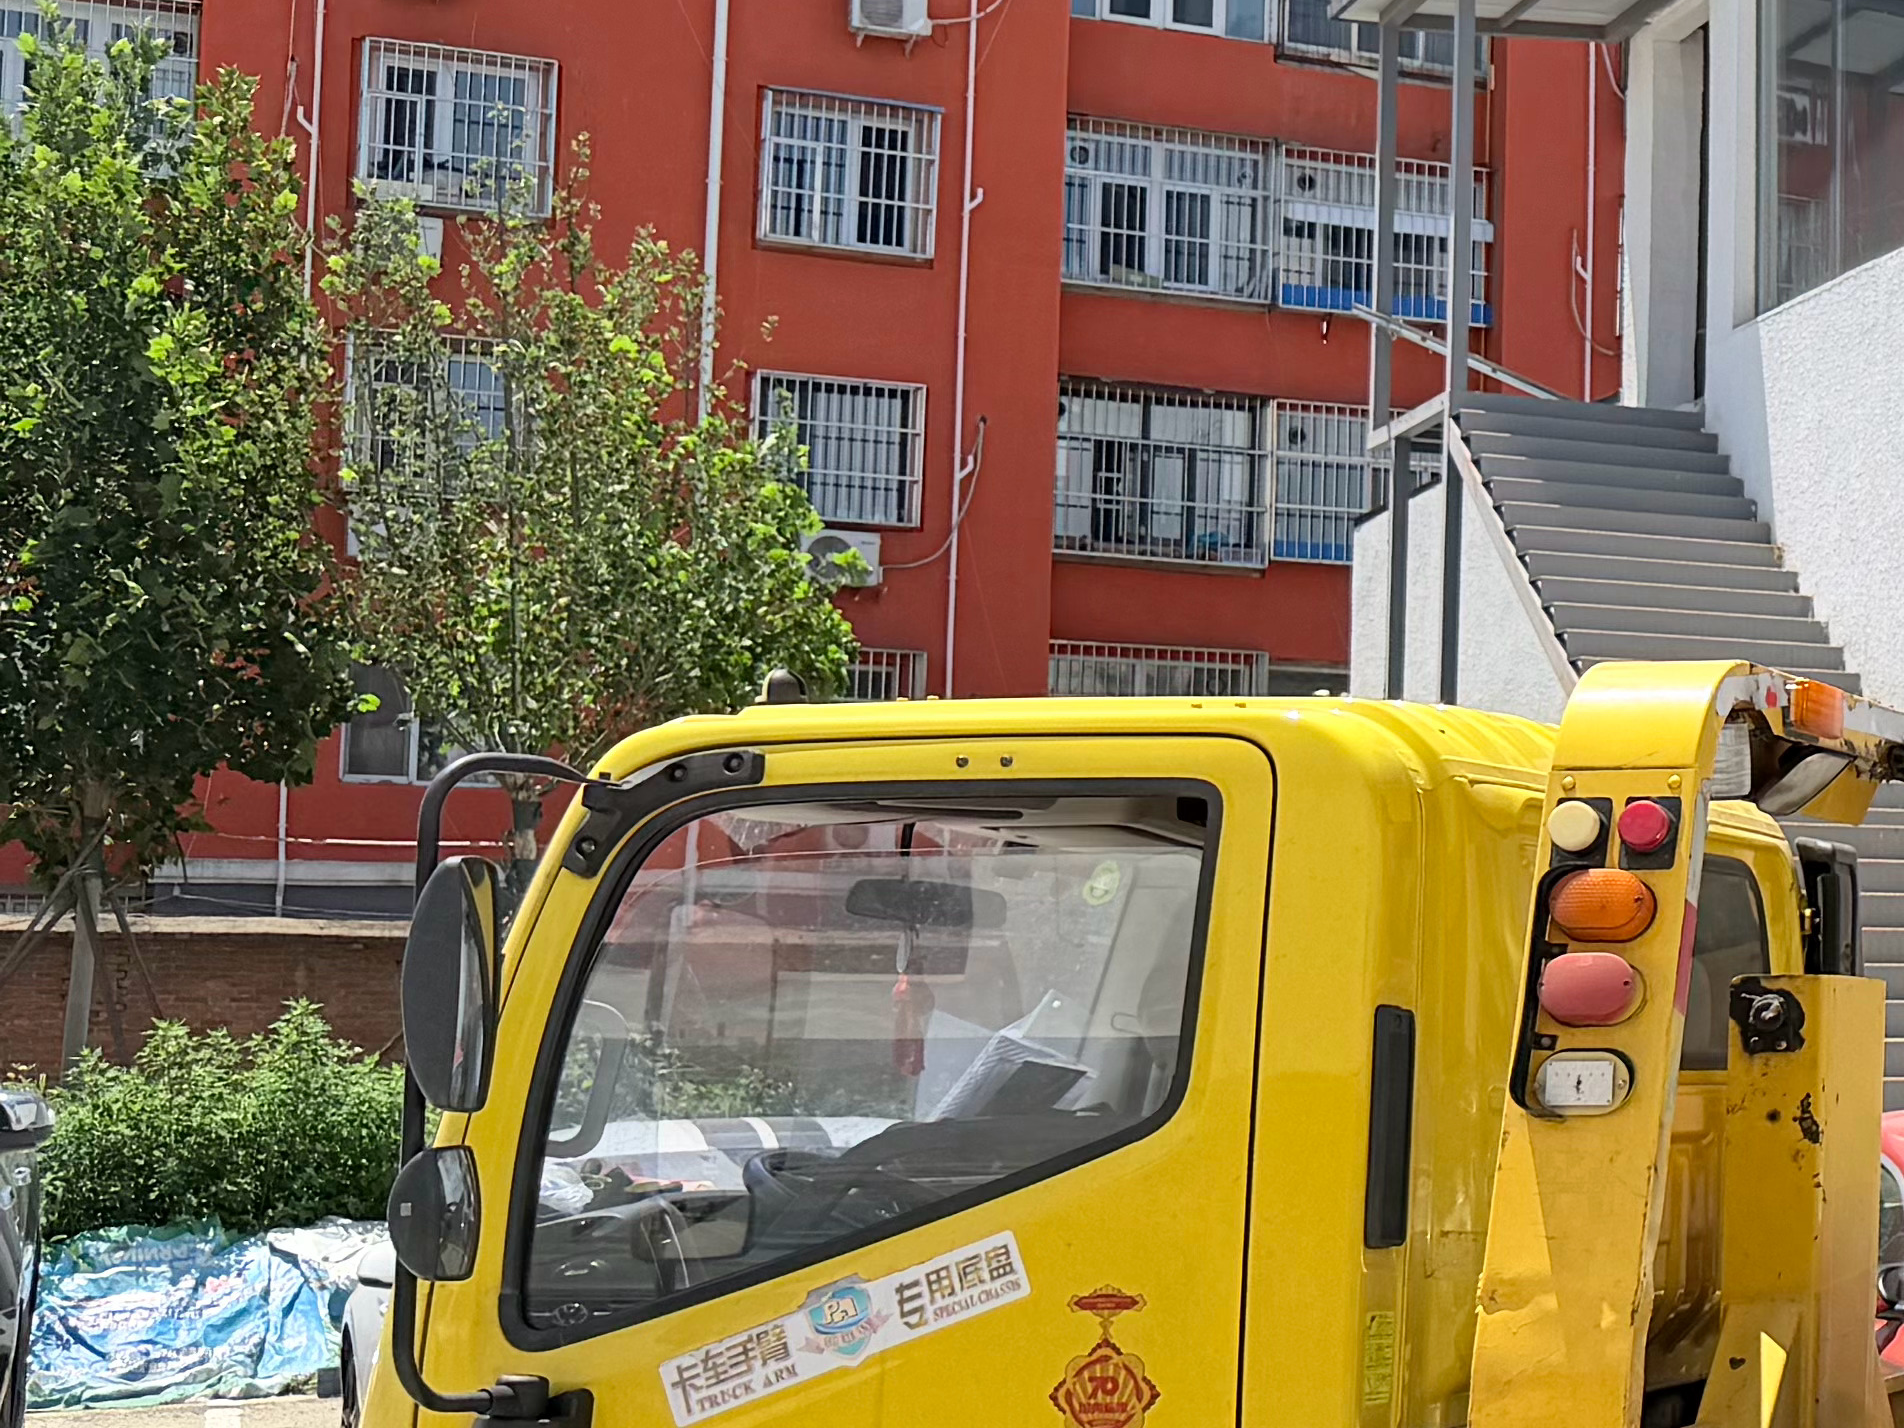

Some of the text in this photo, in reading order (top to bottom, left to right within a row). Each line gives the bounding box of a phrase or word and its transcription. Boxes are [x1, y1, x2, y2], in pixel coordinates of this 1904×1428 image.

[895, 1243, 1016, 1330] 专用底盘
[671, 1323, 795, 1417] 卡车手臂
[696, 1363, 799, 1412] TRUCK ARM
